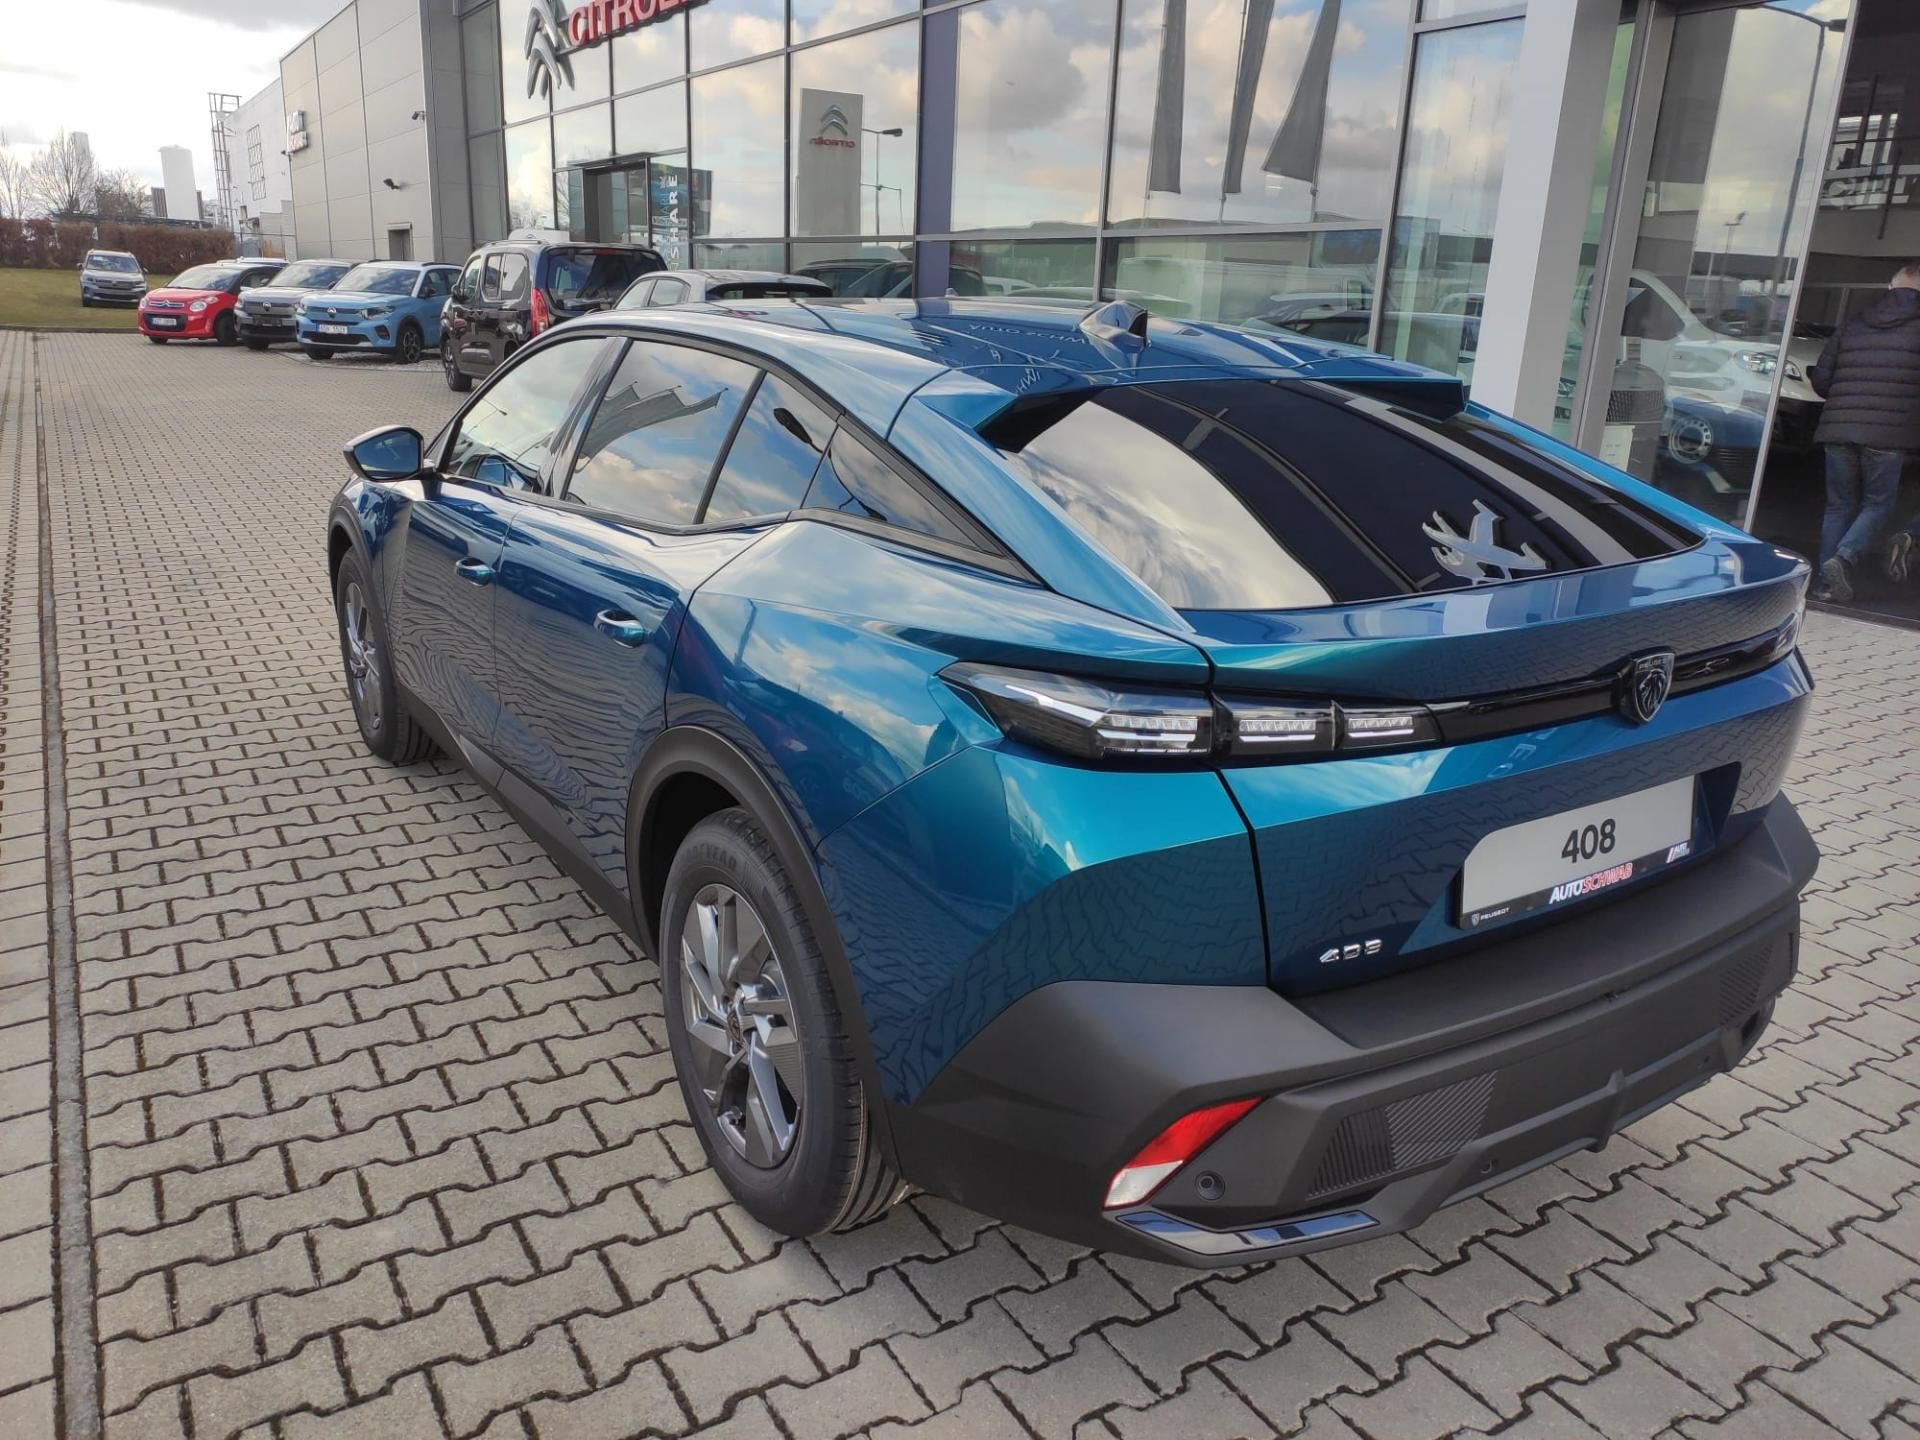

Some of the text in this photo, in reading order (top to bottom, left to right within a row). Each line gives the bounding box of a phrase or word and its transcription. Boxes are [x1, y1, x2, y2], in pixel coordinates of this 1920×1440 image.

[1561, 818, 1616, 864] 408
[1549, 862, 1633, 904] AUTOSCHWAB
[1480, 906, 1510, 921] PEUGEOT
